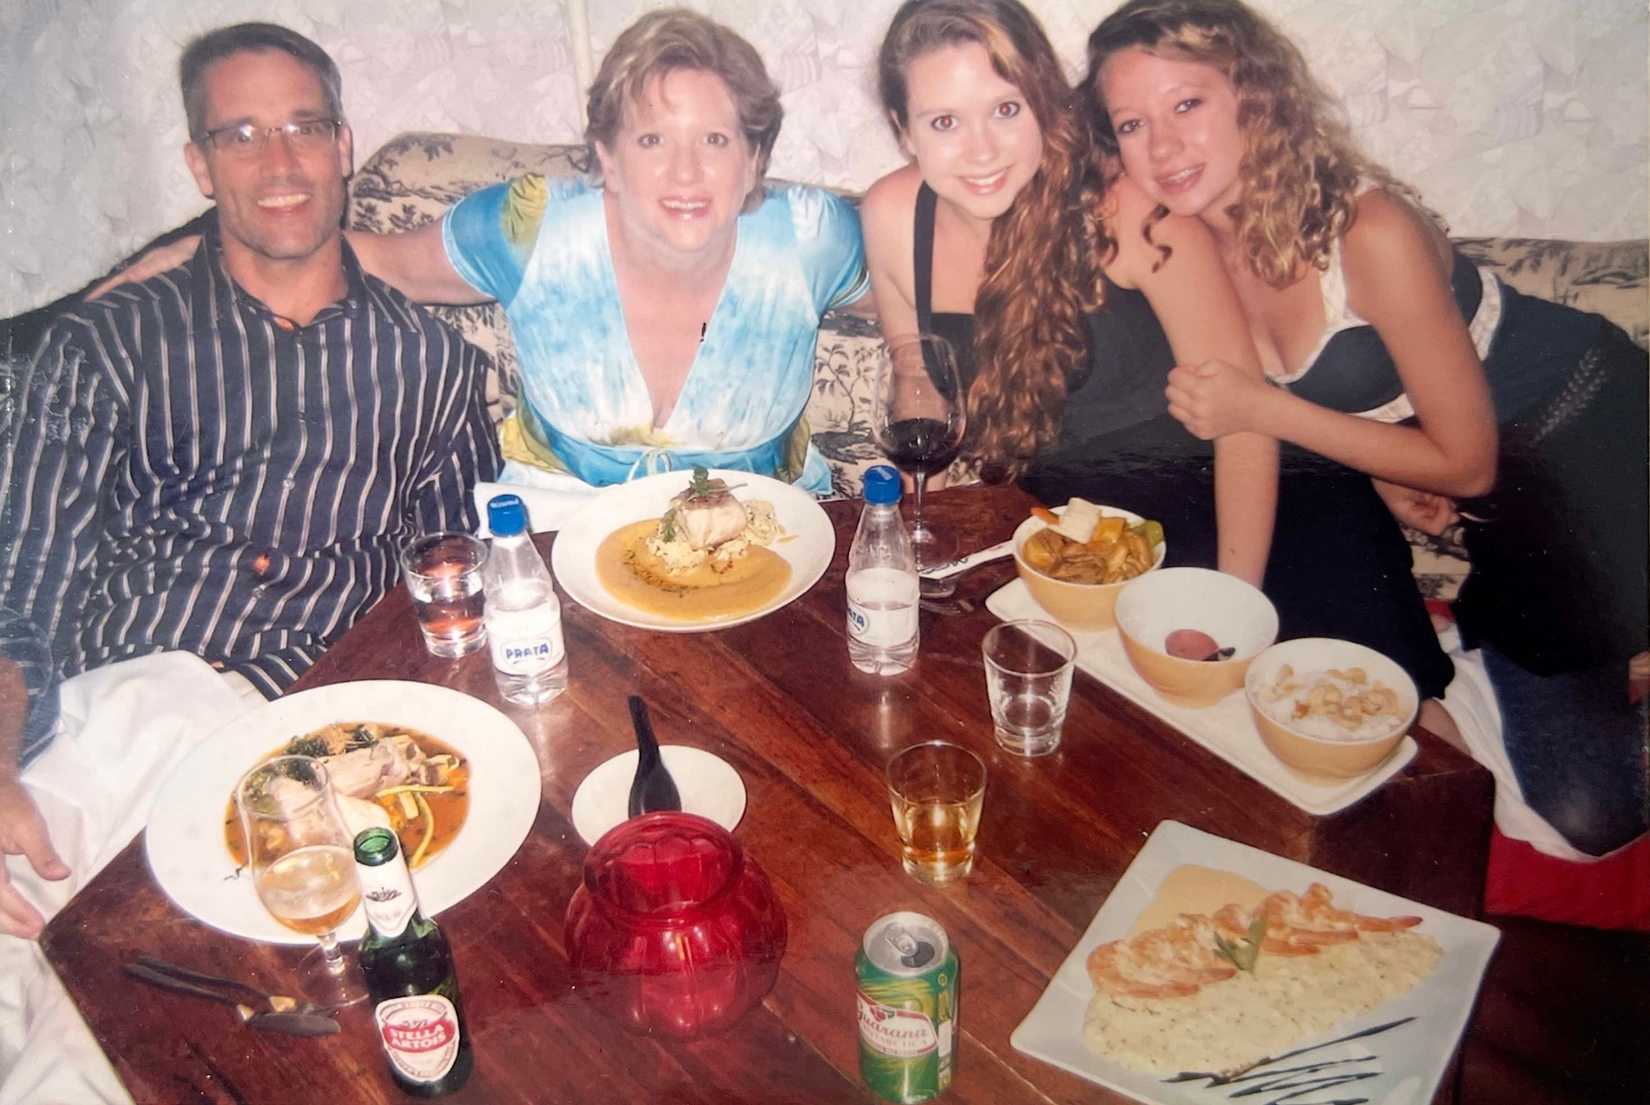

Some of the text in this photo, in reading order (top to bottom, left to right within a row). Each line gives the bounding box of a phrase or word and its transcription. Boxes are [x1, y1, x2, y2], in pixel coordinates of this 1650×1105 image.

[505, 643, 549, 658] PRATA
[389, 1024, 445, 1040] STELLA
[391, 1032, 447, 1049] ARTOIS
